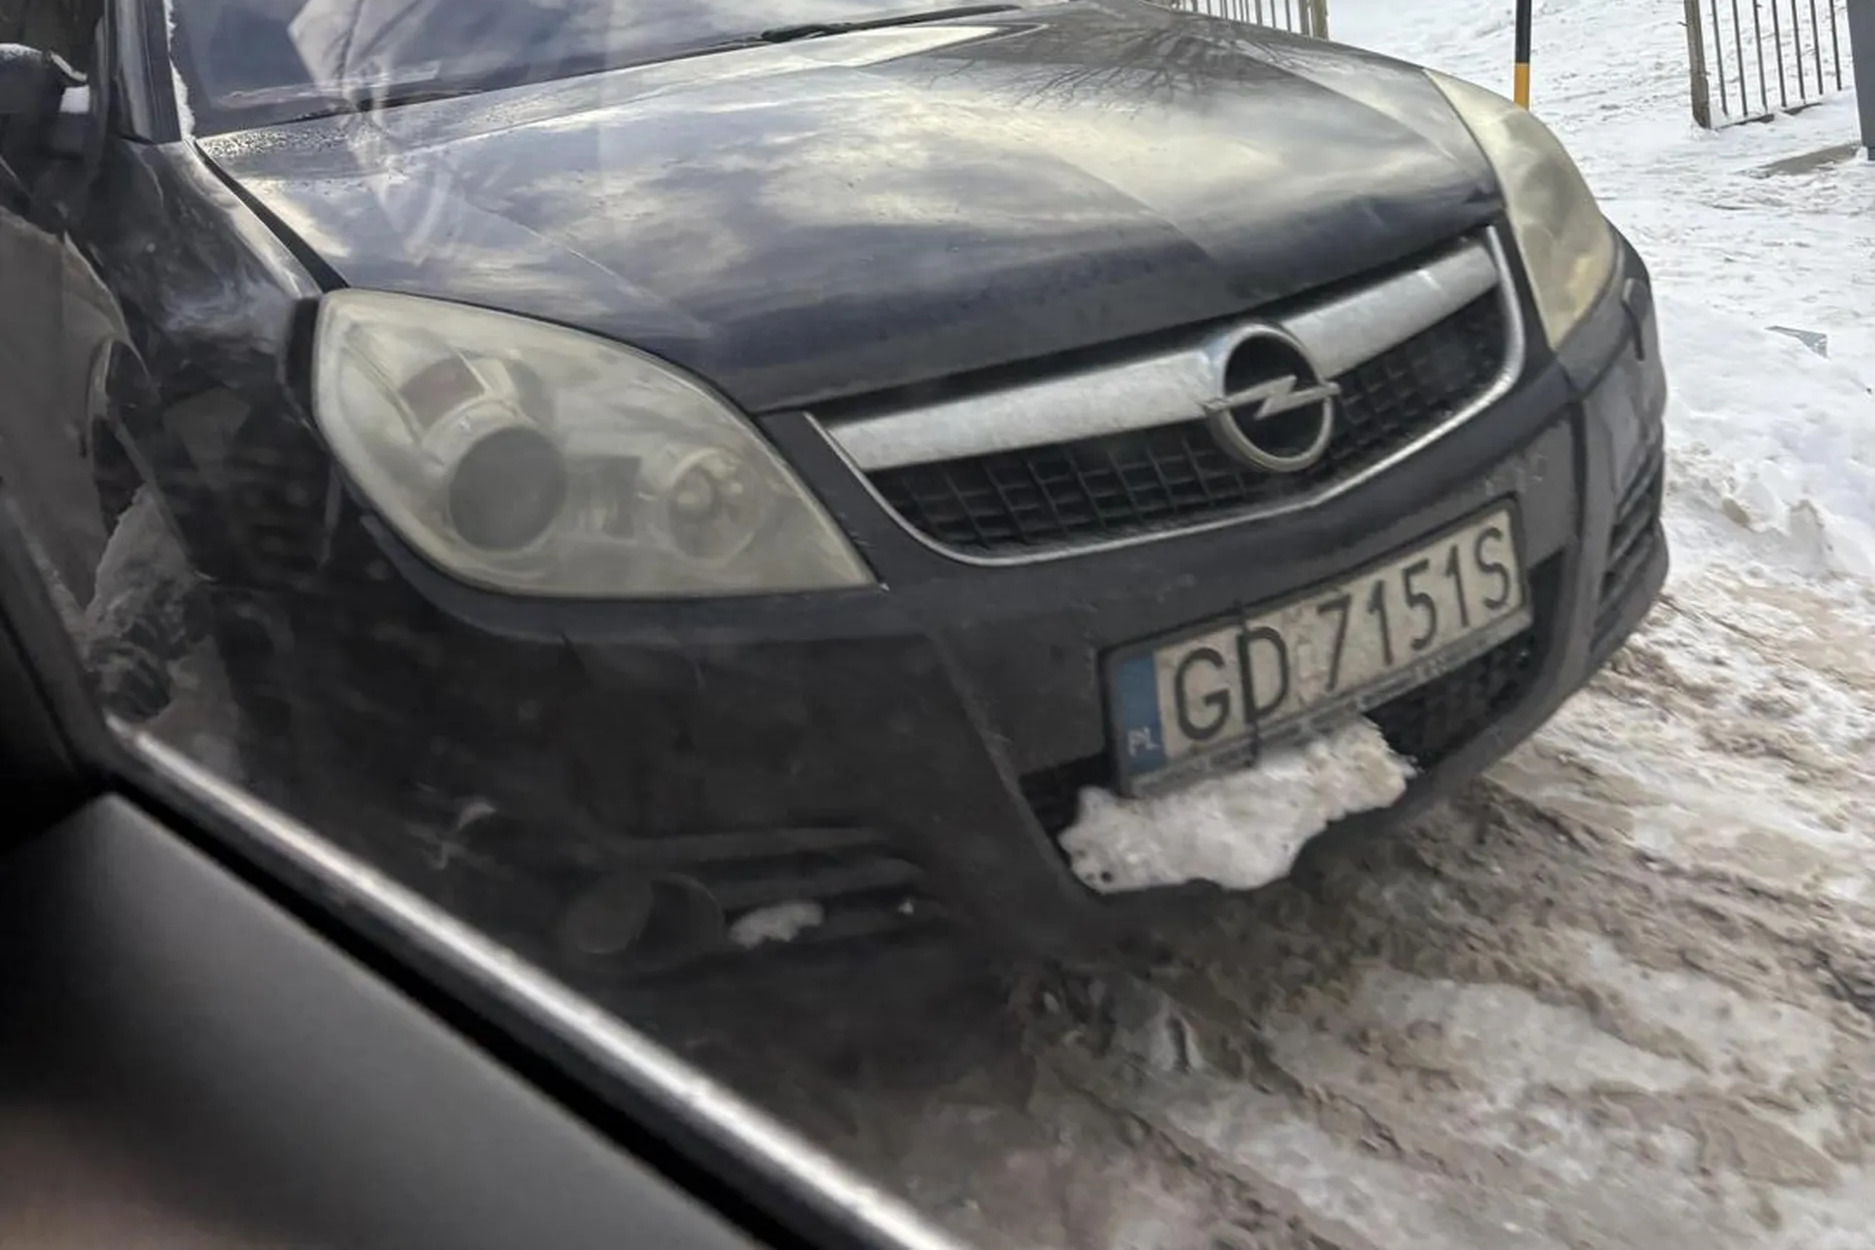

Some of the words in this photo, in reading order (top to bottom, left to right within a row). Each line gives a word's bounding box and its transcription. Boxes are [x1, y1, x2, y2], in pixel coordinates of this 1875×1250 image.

[1127, 726, 1161, 758] PL
[1174, 626, 1289, 740] GD
[1317, 527, 1510, 691] 7151S
